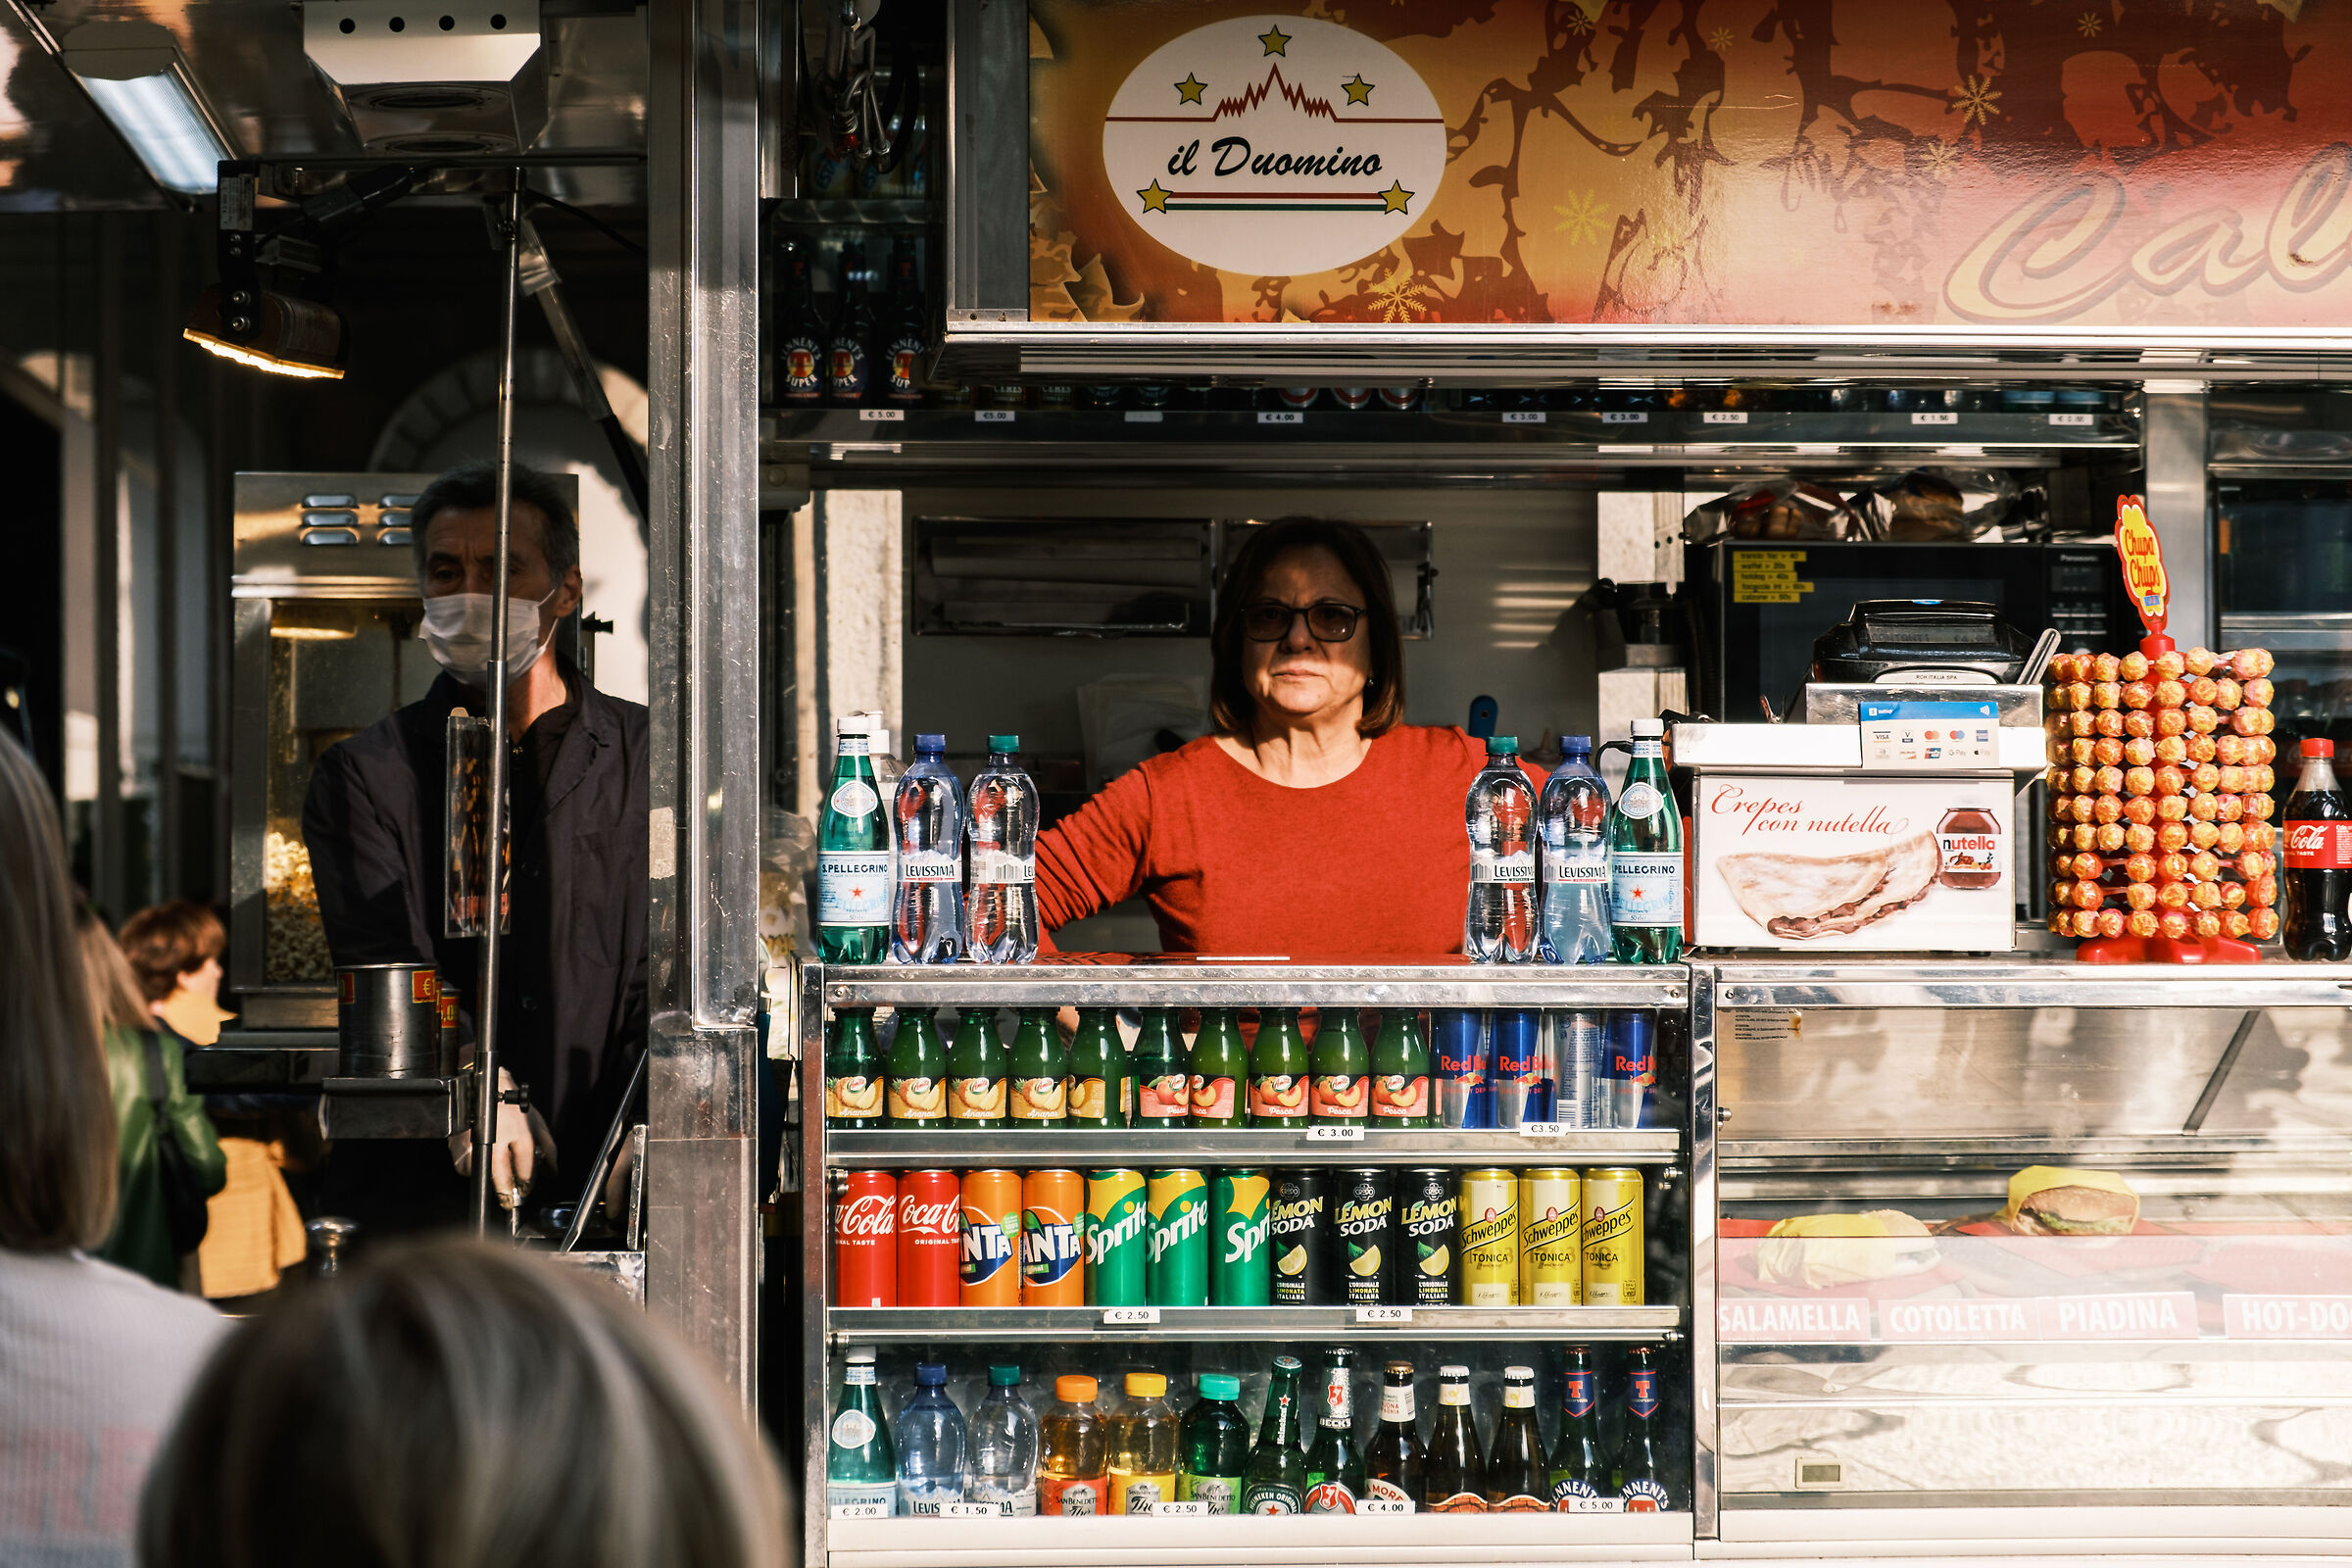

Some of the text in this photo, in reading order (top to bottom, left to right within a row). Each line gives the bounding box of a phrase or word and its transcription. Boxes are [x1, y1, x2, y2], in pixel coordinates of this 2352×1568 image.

[1167, 135, 1383, 177] il Duomino
[784, 373, 818, 388] SUPER
[891, 374, 910, 389] SUP
[2125, 528, 2155, 564] Chupa
[2130, 559, 2161, 593] Chups
[1710, 783, 1803, 836] Crepes
[1757, 805, 1901, 836] con nutella
[1942, 835, 1996, 852] nutella
[2290, 824, 2328, 850] Cola
[906, 864, 956, 878] LEVISSIMA
[1558, 864, 1606, 879] LEVISSIMA
[1441, 1055, 1473, 1072] Red
[1499, 1055, 1530, 1072] Red
[1615, 1055, 1644, 1072] Red
[839, 1108, 871, 1117] Ananas
[903, 1108, 935, 1117] Ananas
[962, 1108, 995, 1117] Ananas
[1027, 1108, 1059, 1117] Ananas
[1269, 1106, 1295, 1115] Pesca
[1326, 1106, 1352, 1115] Pesca
[1383, 1106, 1408, 1115] Pesca
[1317, 1128, 1353, 1137] € 3.00
[1531, 1124, 1559, 1134] €3.50
[1272, 1196, 1324, 1220] EMON
[1334, 1196, 1393, 1225] LEMON
[1400, 1196, 1457, 1225] LEMON
[1086, 1200, 1147, 1265] Sprite
[1146, 1200, 1208, 1264] Sprite
[1225, 1205, 1270, 1263] Spri
[1271, 1215, 1315, 1236] SODA
[1340, 1215, 1388, 1238] SODA
[1408, 1215, 1454, 1238] SODA
[1461, 1209, 1517, 1248] Schweppes
[1523, 1207, 1580, 1249] Schweppes
[963, 1225, 1012, 1262] NTA
[1024, 1225, 1082, 1263] ANTA
[1472, 1252, 1508, 1262] TONICA
[1535, 1252, 1570, 1262] TONICA
[1586, 1251, 1618, 1262] TONICA
[1889, 1301, 2028, 1333] COTOLETTA
[2059, 1298, 2179, 1333] PIADINA
[1276, 1405, 1288, 1446] Heineken
[1249, 1491, 1275, 1510] HEINEKEN
[1551, 1479, 1597, 1511] TENNENT
[1622, 1480, 1670, 1511] NNENT'S
[843, 1507, 850, 1516] €
[1163, 1504, 1198, 1513] € 2.50
[1380, 1503, 1404, 1512] 4.00
[1579, 1500, 1613, 1510] € 5.00
